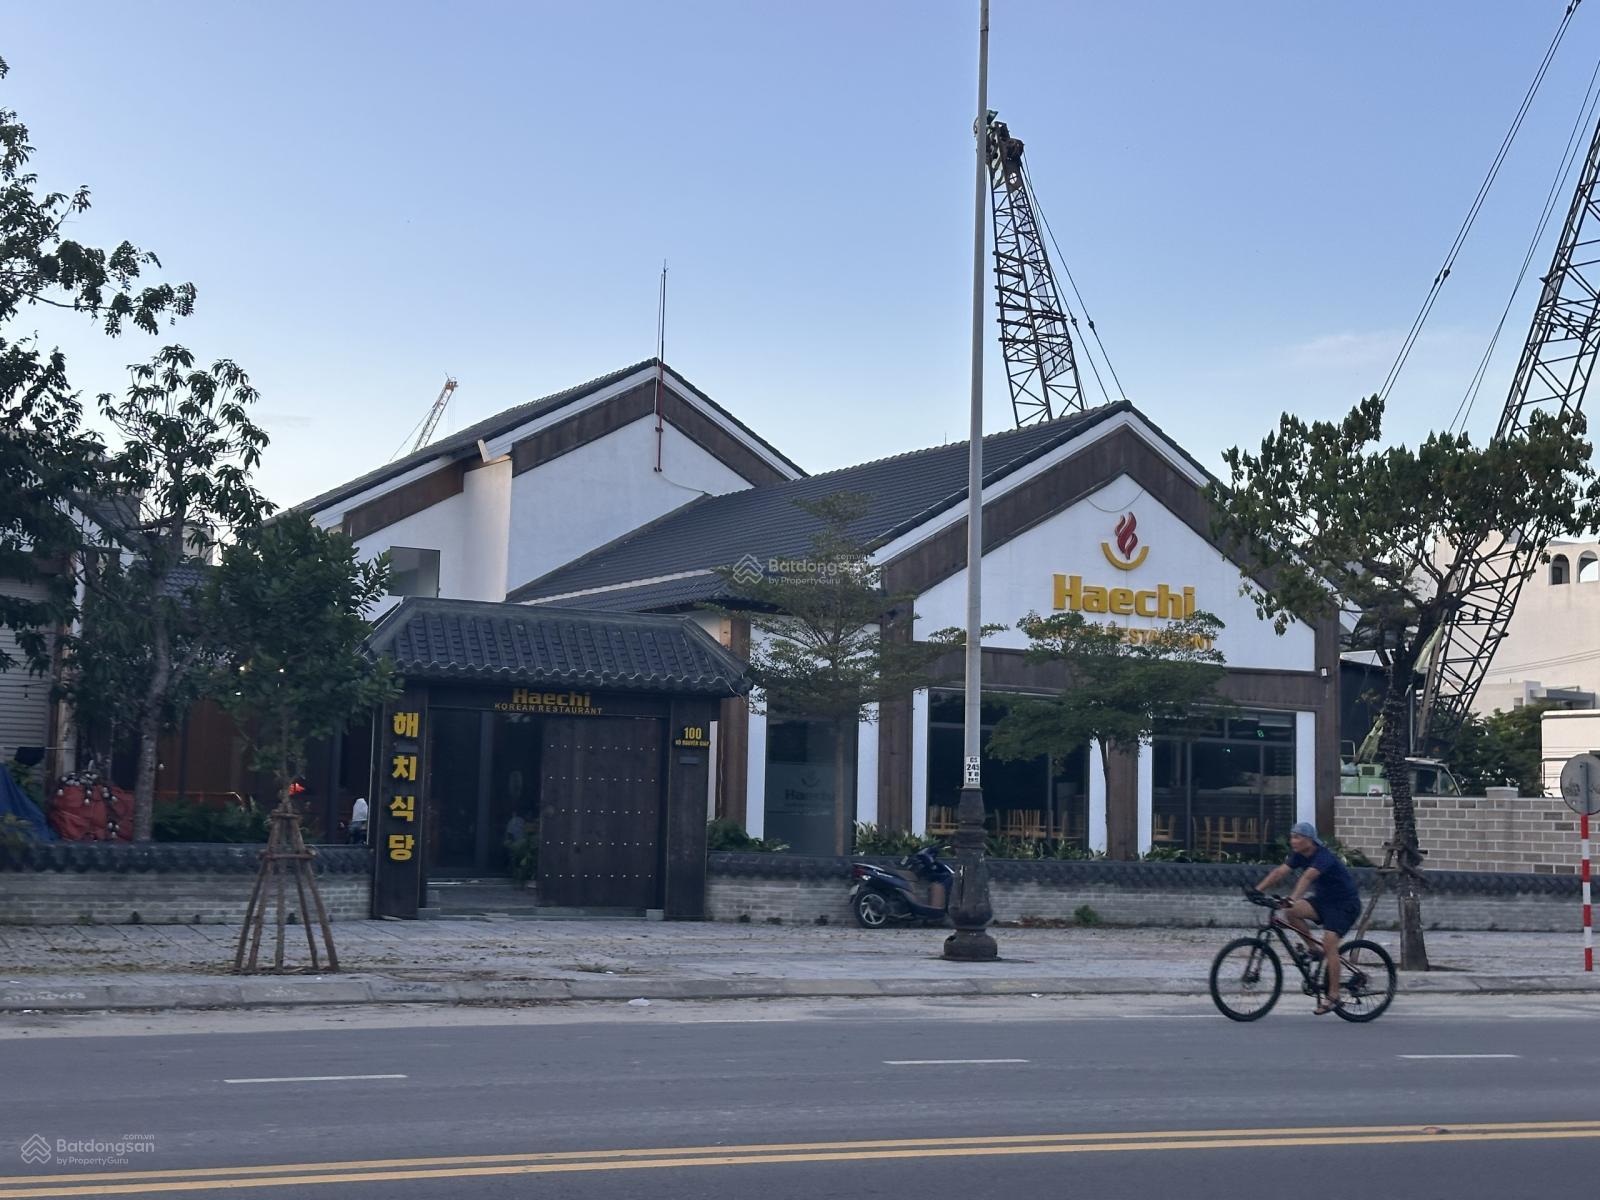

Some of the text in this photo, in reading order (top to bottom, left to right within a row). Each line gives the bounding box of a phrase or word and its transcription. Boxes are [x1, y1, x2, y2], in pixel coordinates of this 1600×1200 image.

[1052, 574, 1195, 620] Haechi
[512, 688, 591, 707] Haechi
[495, 703, 603, 715] KOREAN RESTAURANT
[684, 727, 702, 740] 100
